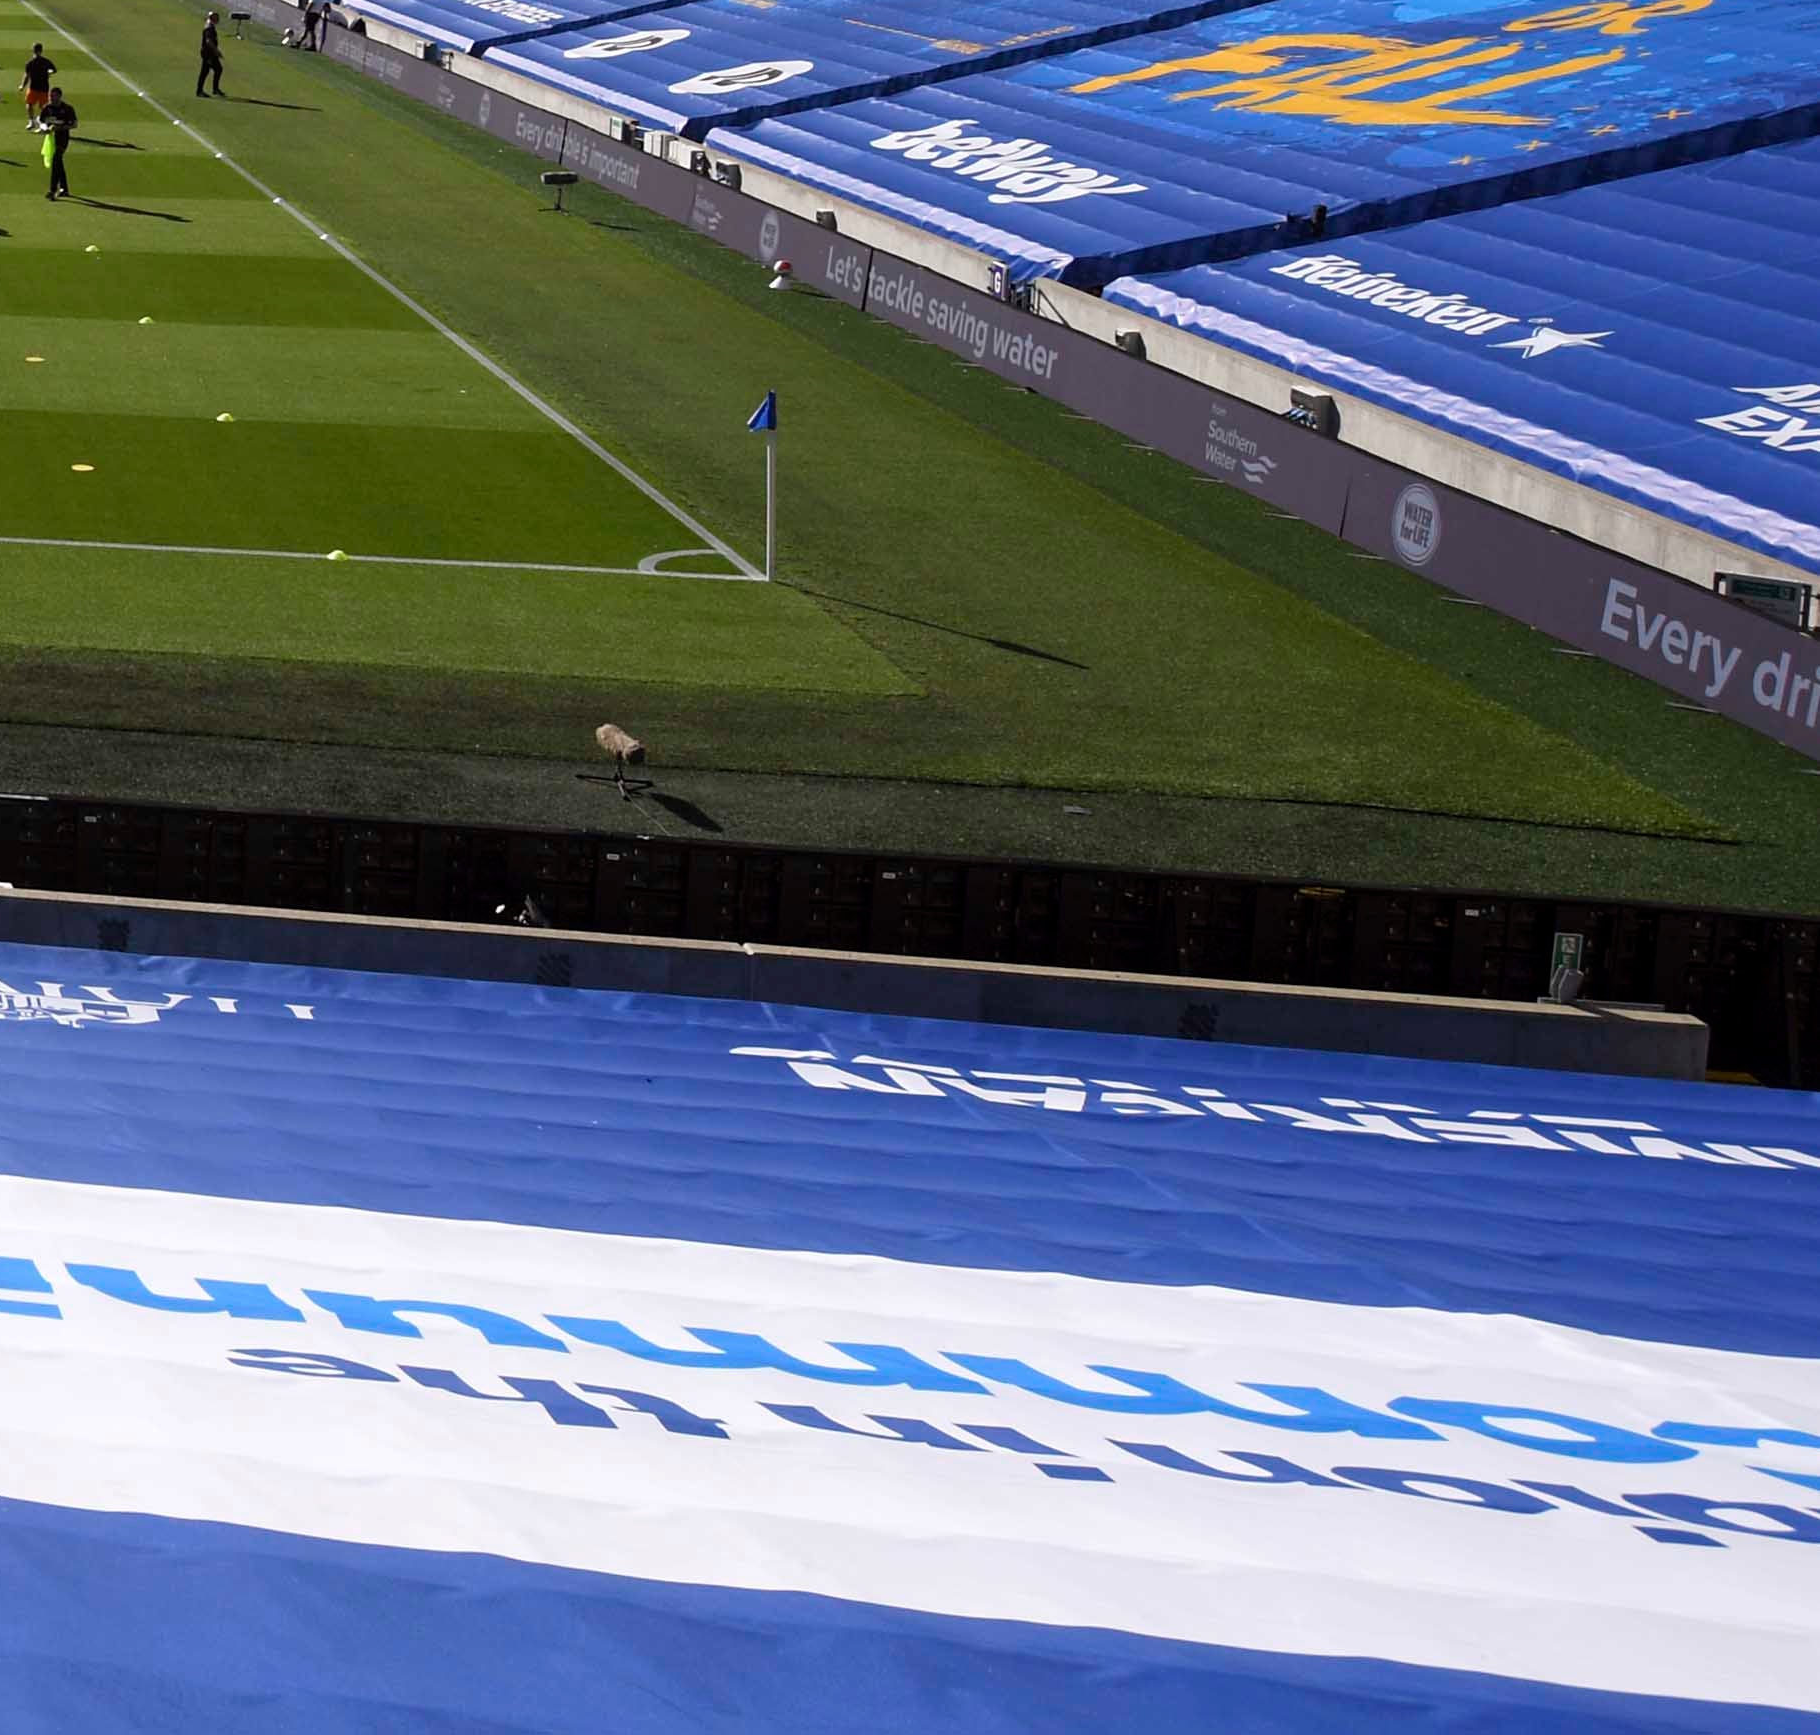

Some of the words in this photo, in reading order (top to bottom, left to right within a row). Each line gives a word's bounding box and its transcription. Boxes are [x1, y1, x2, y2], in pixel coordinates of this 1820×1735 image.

[516, 112, 547, 150] Every
[869, 119, 1150, 205] betway
[825, 245, 863, 294] Let's
[867, 265, 924, 318] tackle
[927, 297, 990, 359] saving
[992, 326, 1058, 379] water
[993, 271, 1003, 293] G
[1267, 253, 1521, 336] Heineken
[1204, 443, 1239, 472] Water
[1208, 419, 1259, 458] Southern
[1403, 500, 1434, 531] WATER
[1600, 577, 1744, 698] Every
[226, 1347, 735, 1441] the
[753, 1398, 1117, 1485] in
